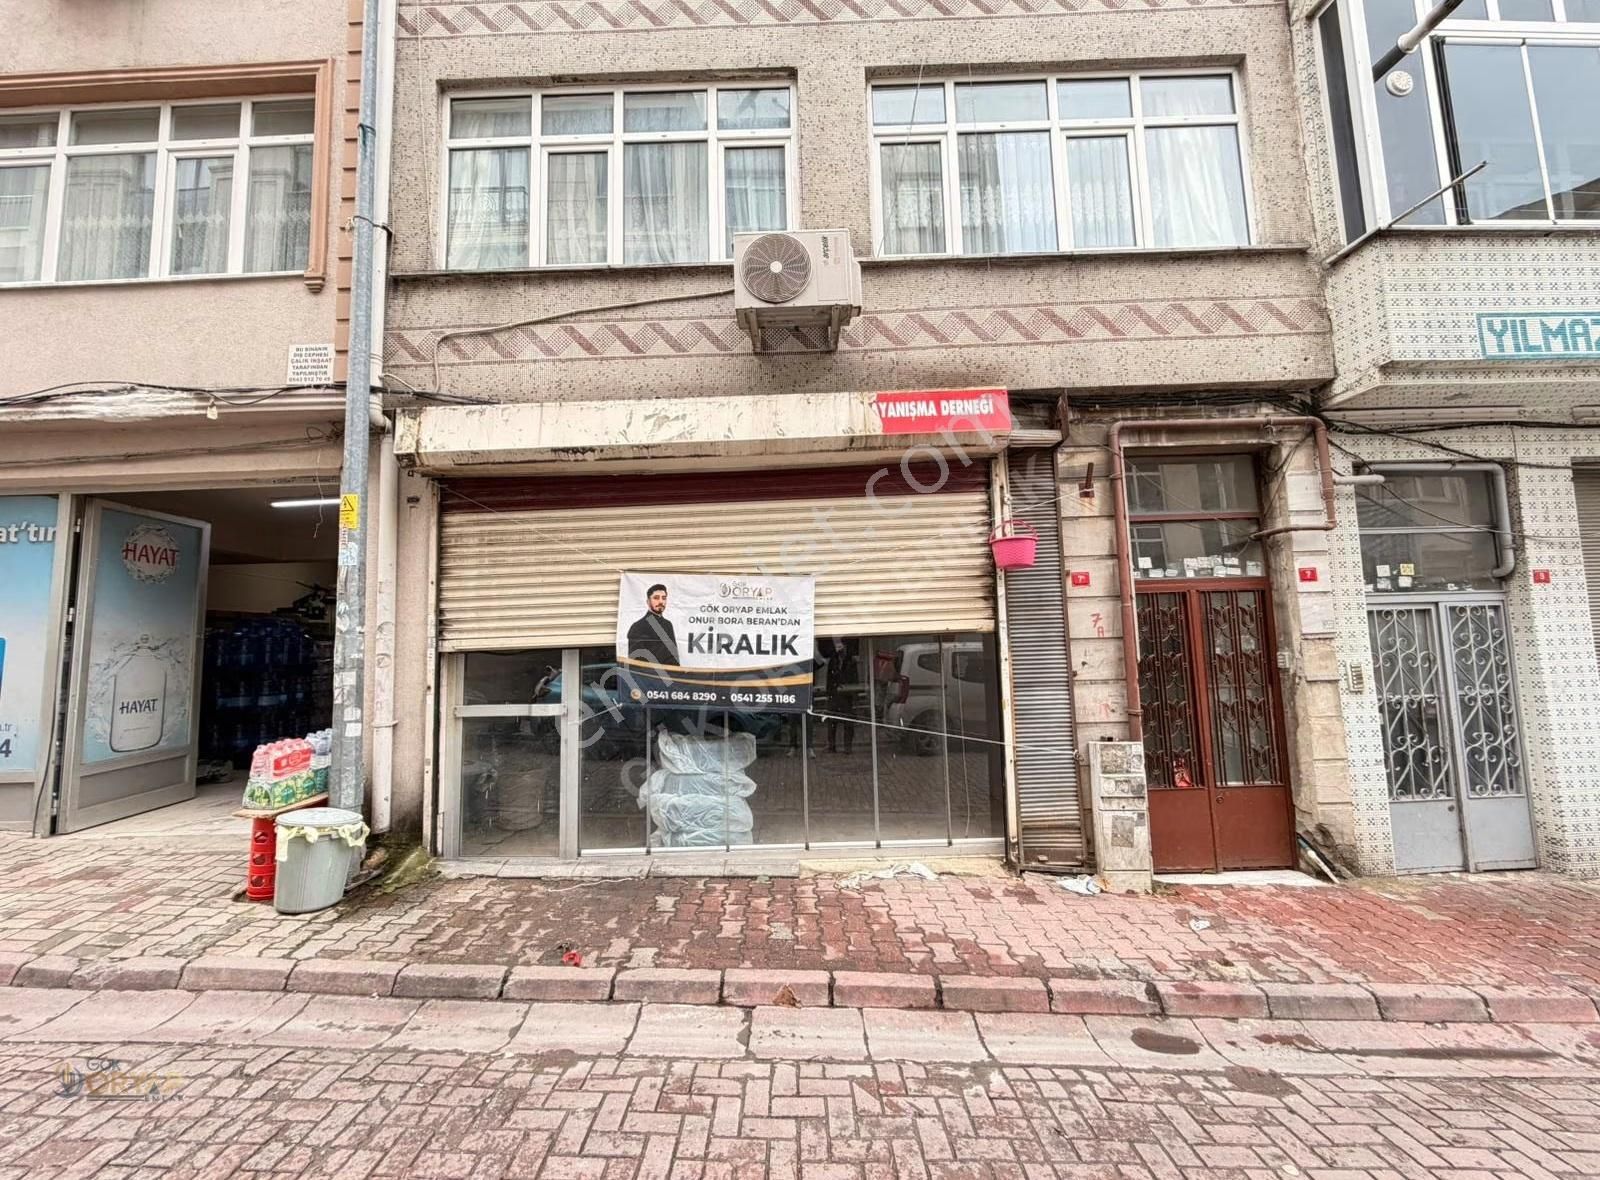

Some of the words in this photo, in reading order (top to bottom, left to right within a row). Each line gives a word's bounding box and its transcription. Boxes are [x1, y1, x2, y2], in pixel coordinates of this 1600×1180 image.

[941, 396, 995, 416] DERNEĞİ
[122, 543, 179, 567] HAYAT
[700, 604, 719, 613] GÖK
[722, 605, 753, 614] ORYAP
[756, 606, 788, 615] EMLAK
[688, 616, 715, 624] ONUR
[718, 617, 744, 625] BORA
[746, 617, 801, 626] BERAN'DAN
[687, 626, 799, 656] KİRALIK
[646, 690, 669, 699] 0541
[671, 691, 690, 700] 684
[692, 691, 717, 701] 8290
[730, 693, 753, 702] 0541
[755, 693, 773, 703] 255
[775, 694, 796, 704] 1186
[119, 699, 158, 715] HAYAT
